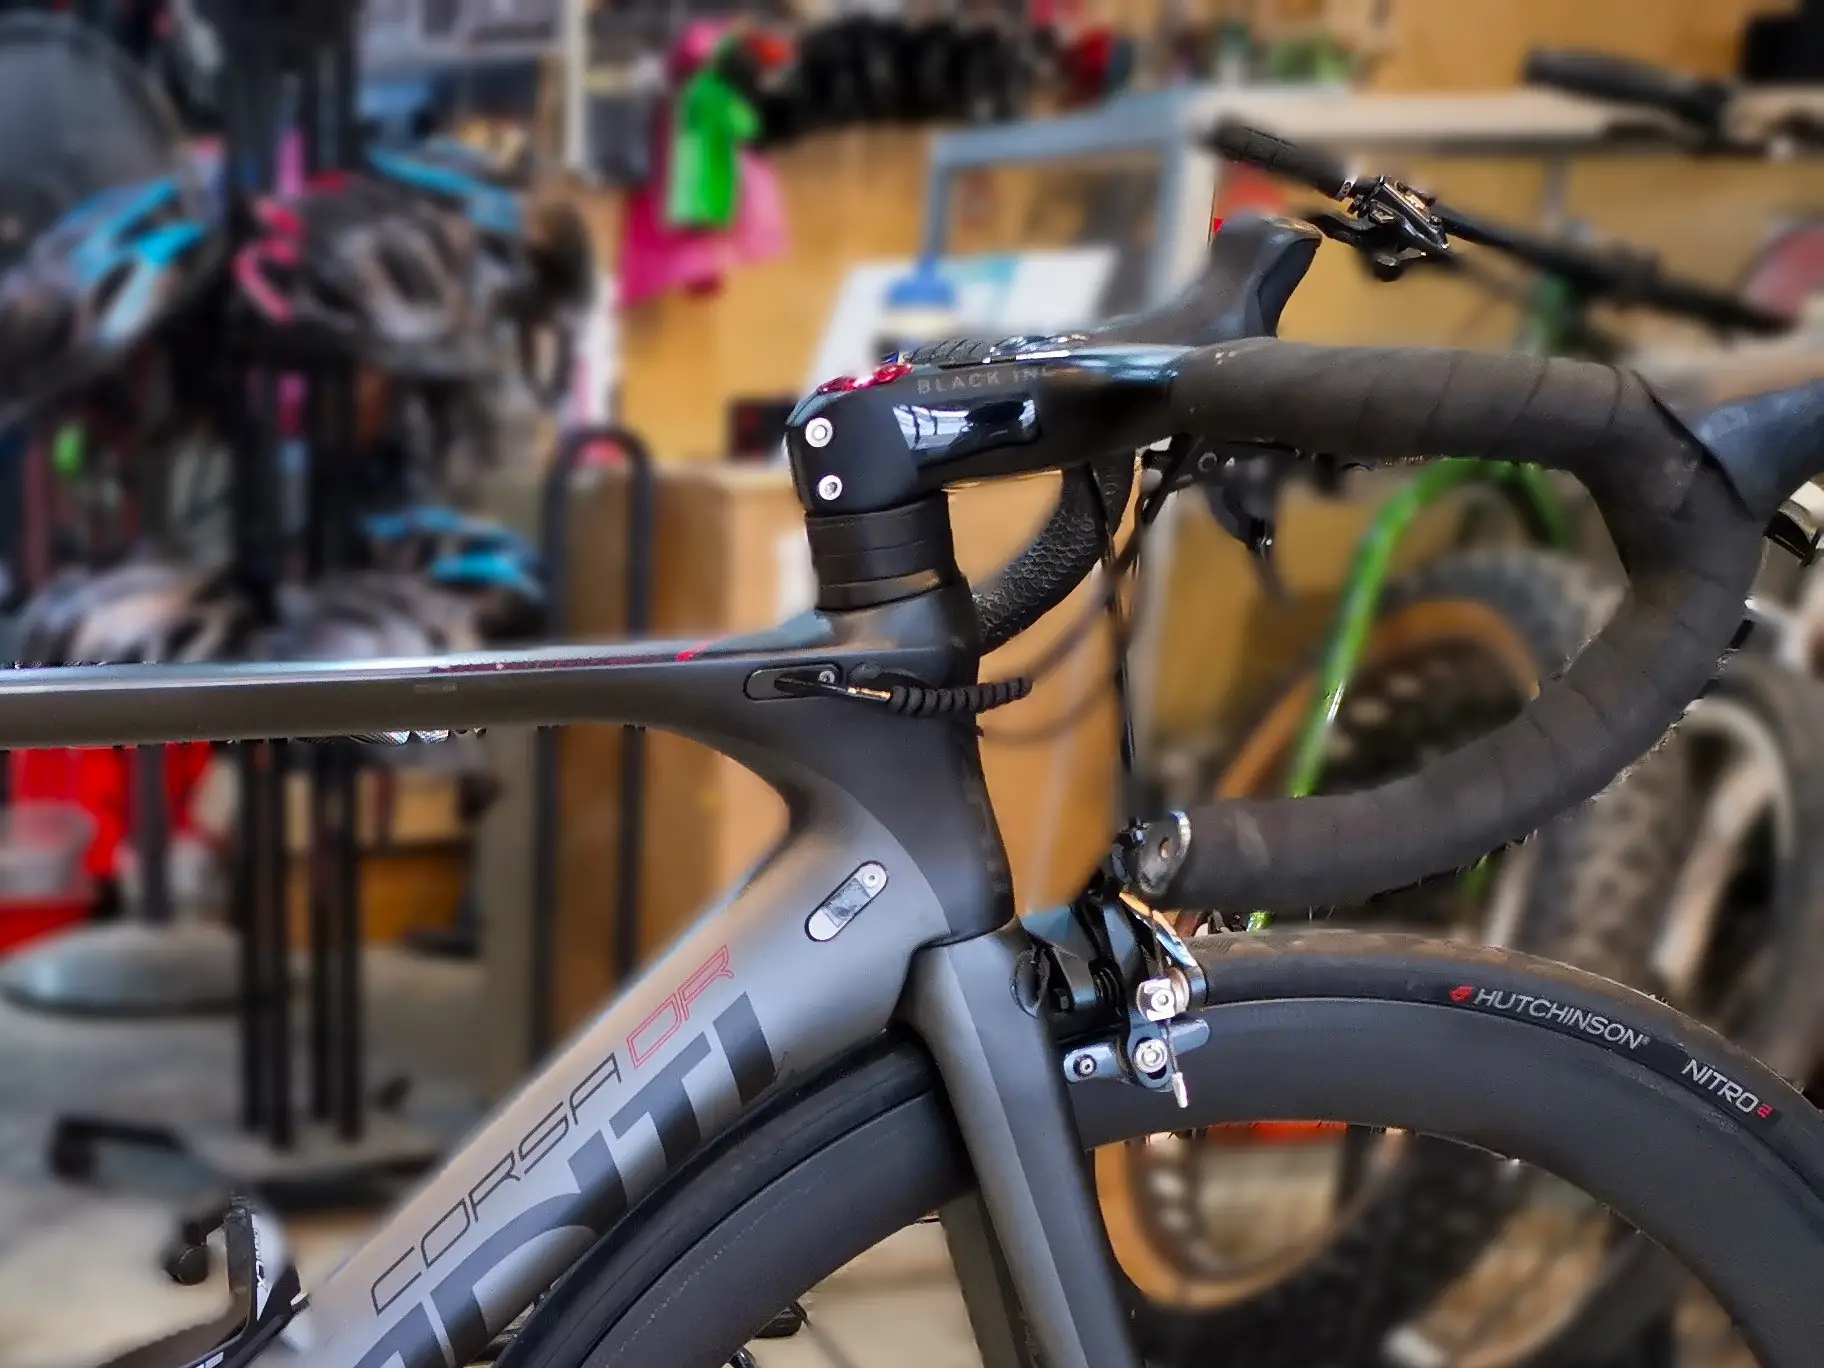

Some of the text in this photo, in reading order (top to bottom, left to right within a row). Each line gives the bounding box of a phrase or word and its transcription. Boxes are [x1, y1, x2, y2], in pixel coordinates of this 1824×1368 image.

[917, 370, 999, 394] BLACK
[371, 945, 736, 1315] CORSA DR
